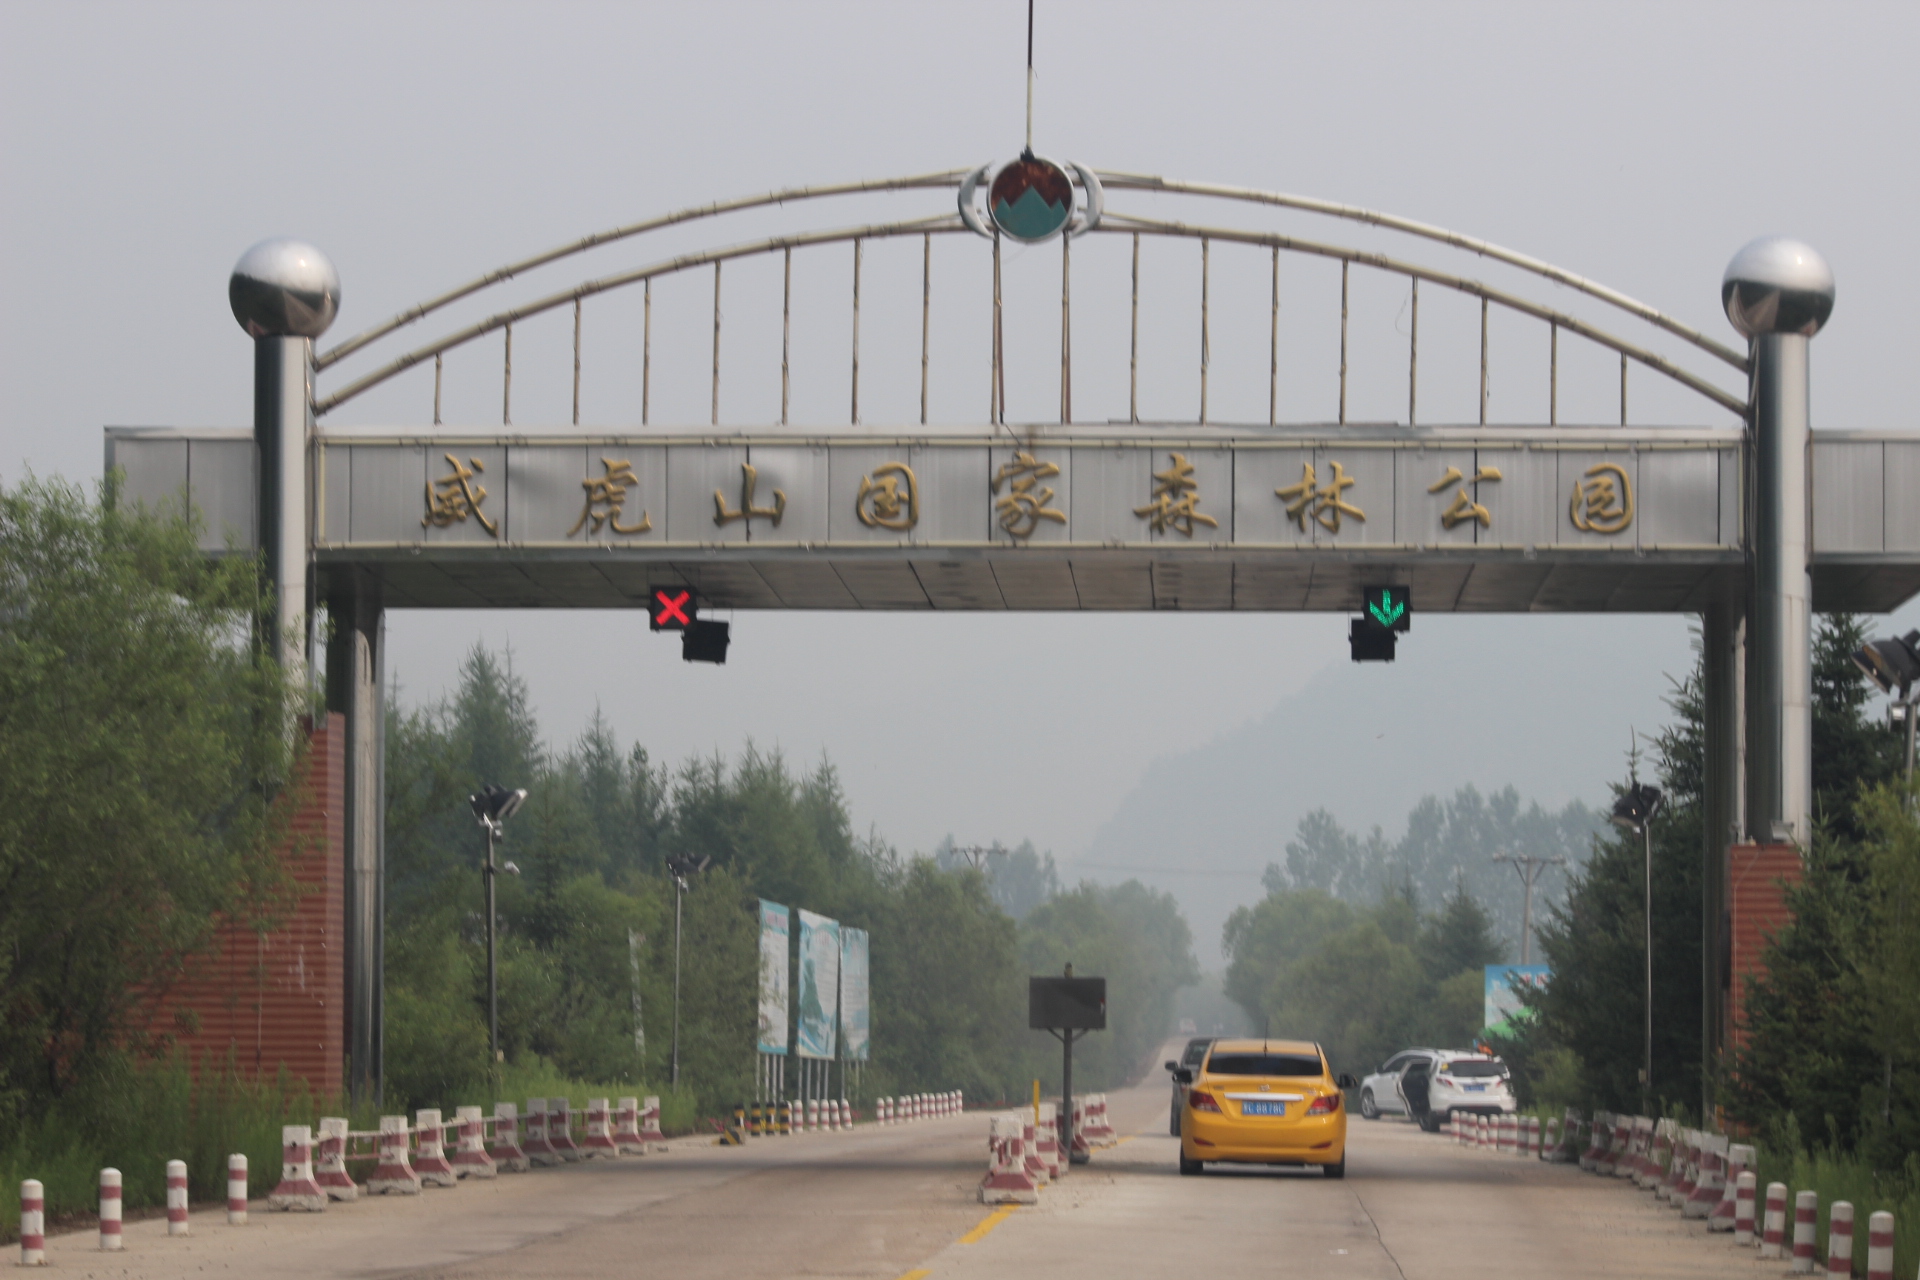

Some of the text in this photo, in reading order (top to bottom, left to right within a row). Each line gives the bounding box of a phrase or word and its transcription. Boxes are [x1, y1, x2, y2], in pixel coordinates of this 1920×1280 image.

[421, 452, 1633, 538] 威虎山国家森林公园
